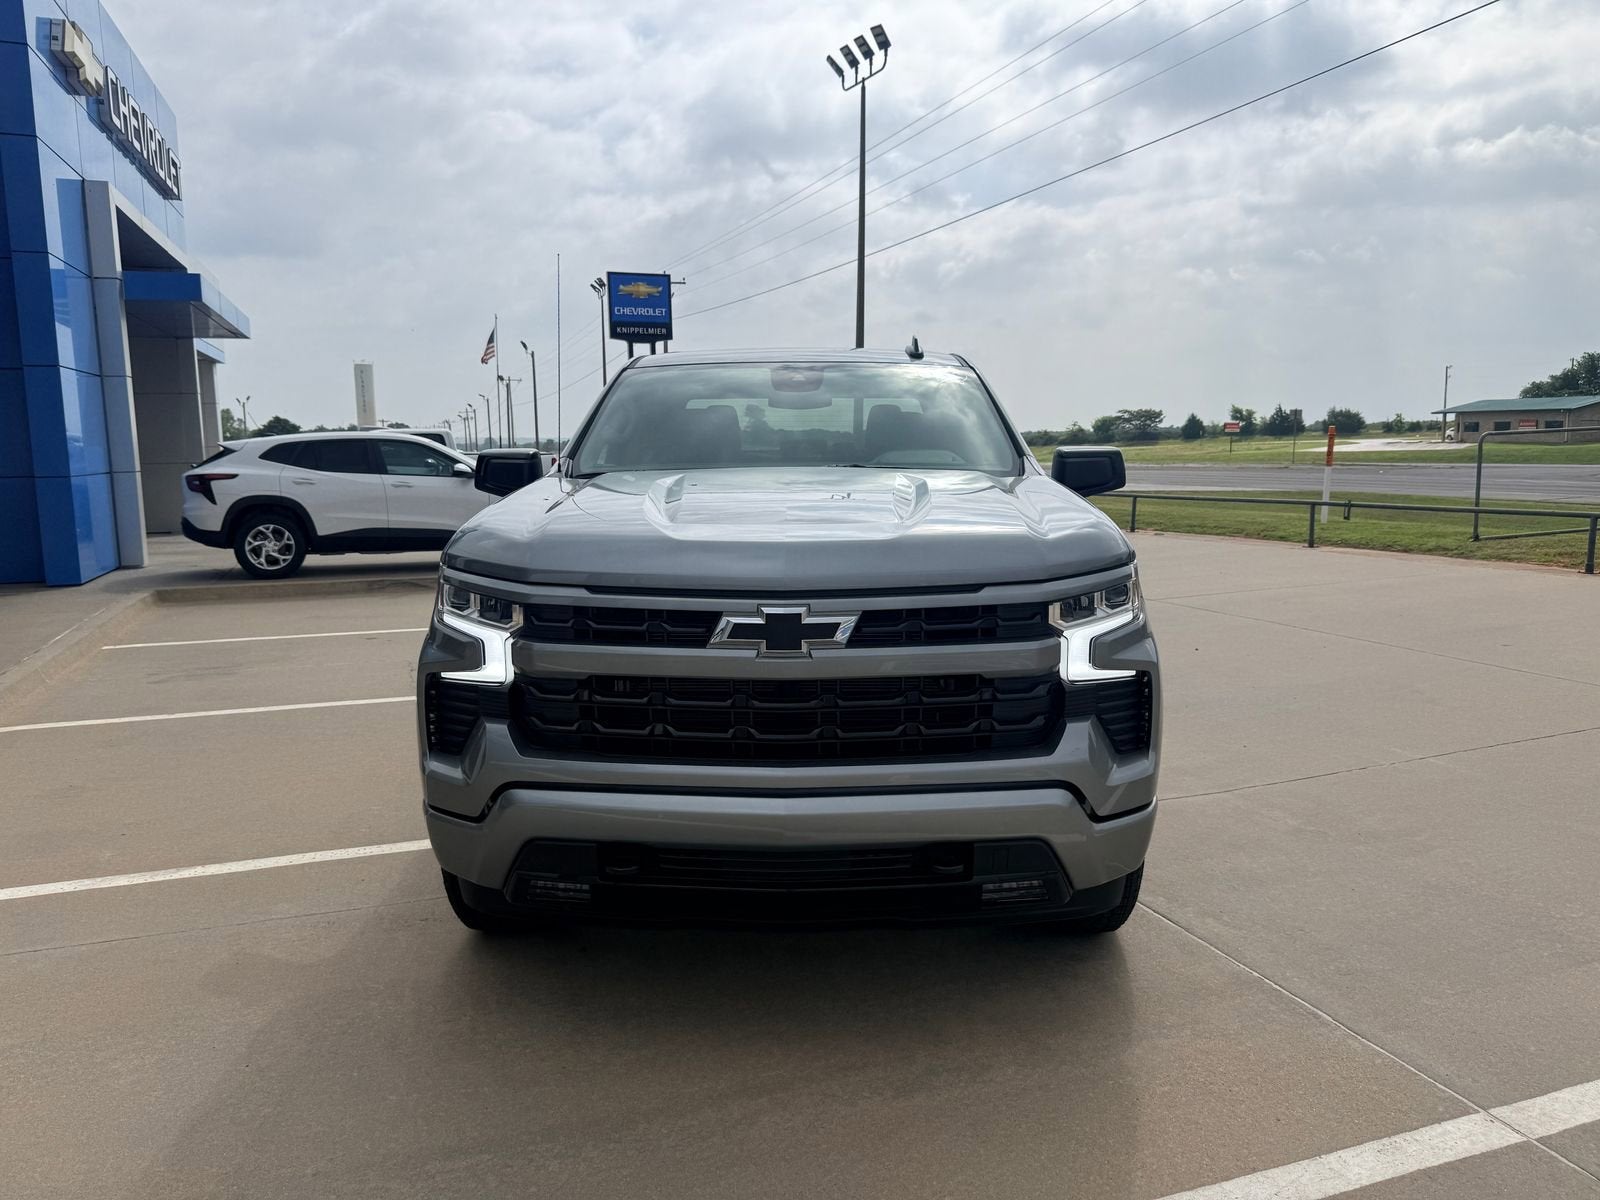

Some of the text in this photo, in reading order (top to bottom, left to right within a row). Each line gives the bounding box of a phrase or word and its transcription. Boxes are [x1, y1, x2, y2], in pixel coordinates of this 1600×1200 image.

[106, 65, 181, 199] CHEVROLET
[614, 306, 667, 316] CHEVROLET
[616, 326, 667, 335] KNIPPELMIER
